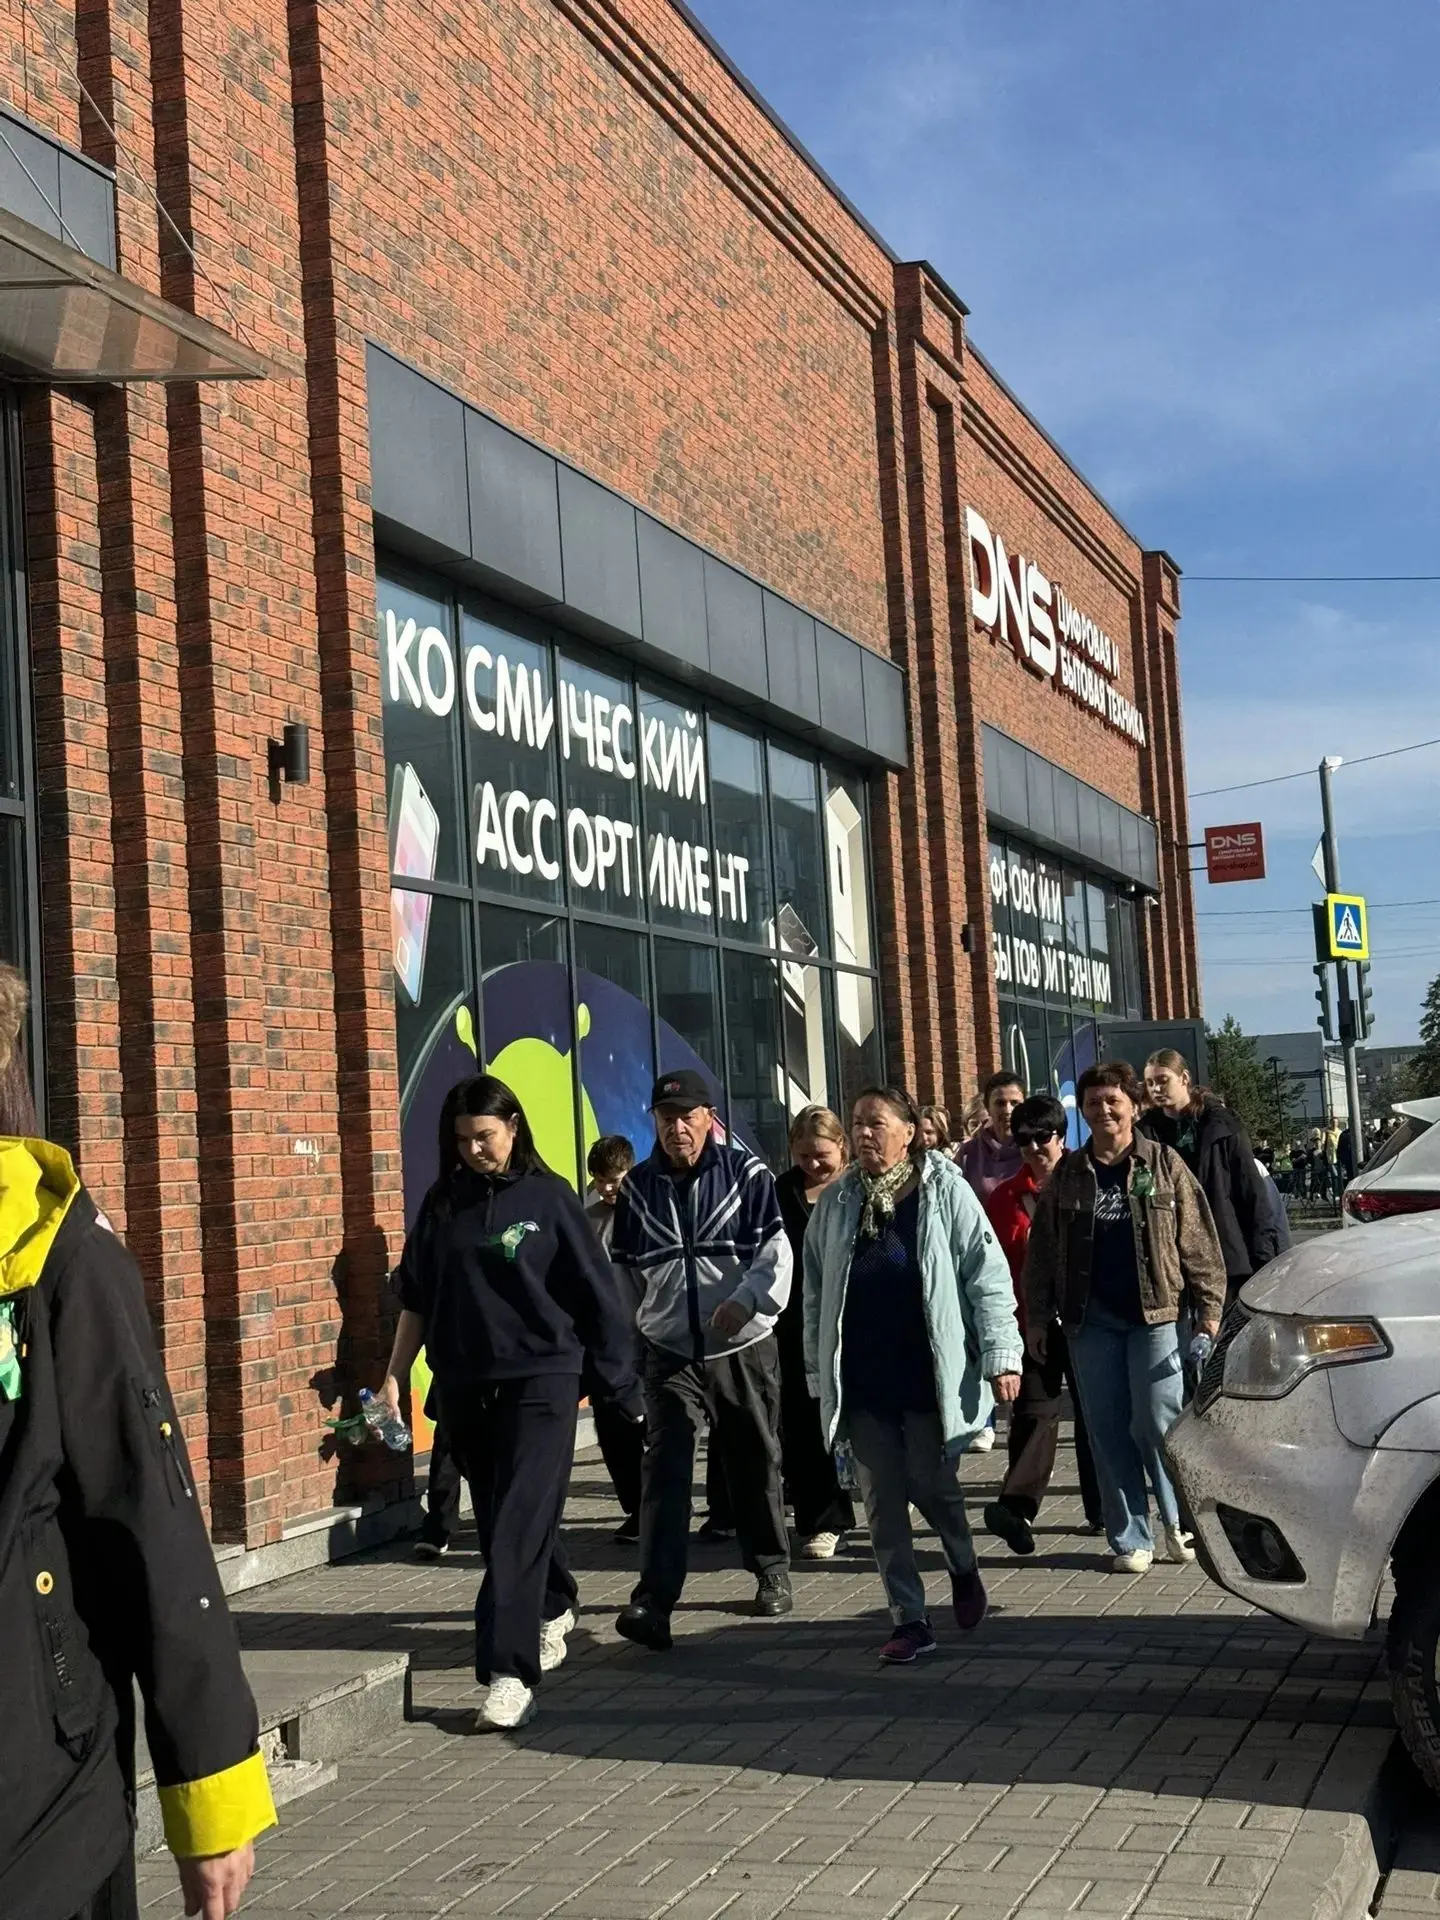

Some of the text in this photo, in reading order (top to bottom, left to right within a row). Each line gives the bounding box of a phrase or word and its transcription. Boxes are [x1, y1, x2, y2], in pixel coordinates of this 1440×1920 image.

[966, 505, 1057, 676] DNS
[1056, 586, 1121, 680] ЦИФРОВАЯ И
[385, 608, 706, 804] КОСМИЧЕСКИЙ
[1060, 644, 1146, 748] БЫТОВАЯ ТЕХНИКА
[476, 781, 749, 924] АССОРТИМЕНТ
[990, 856, 1051, 922] ФРОВОЙ
[1210, 833, 1257, 850] DNS
